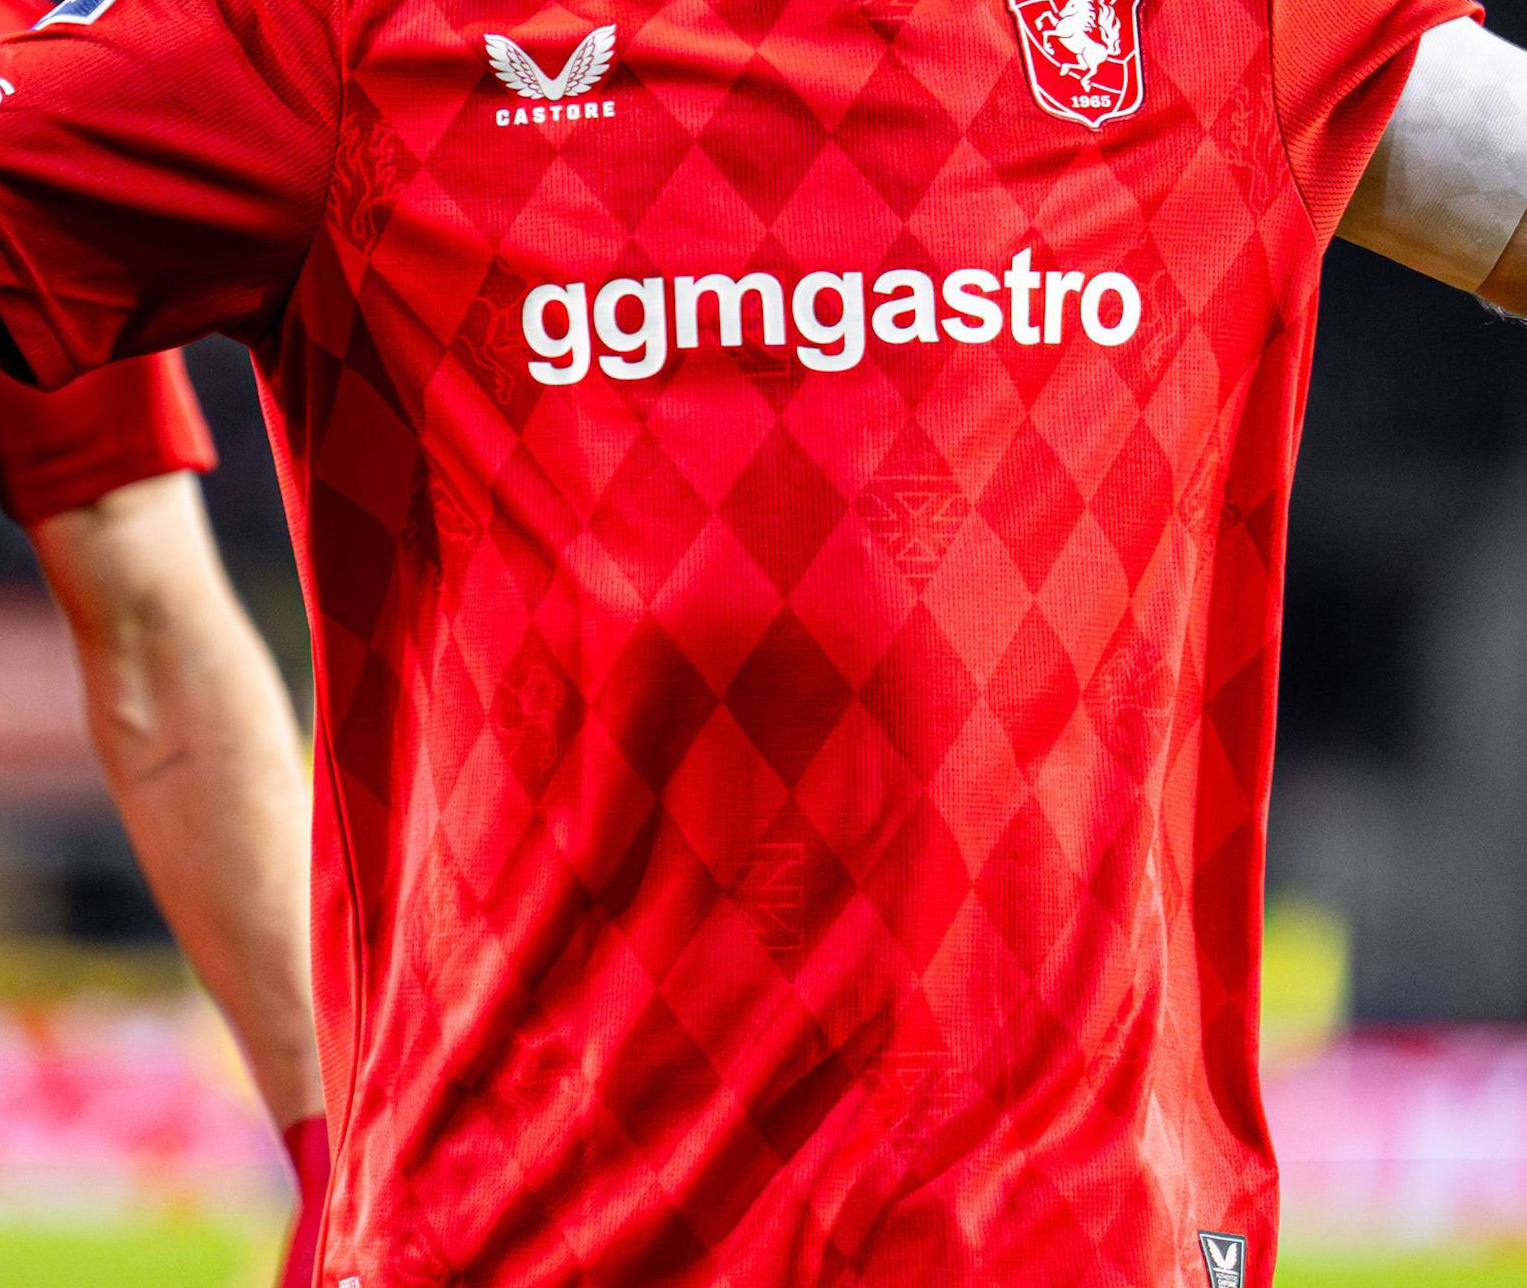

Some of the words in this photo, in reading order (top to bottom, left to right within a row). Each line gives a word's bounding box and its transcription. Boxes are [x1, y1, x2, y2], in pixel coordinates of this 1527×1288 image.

[495, 101, 616, 127] CASTORE
[1071, 94, 1111, 108] 1965
[522, 246, 1142, 386] ggmgastro
